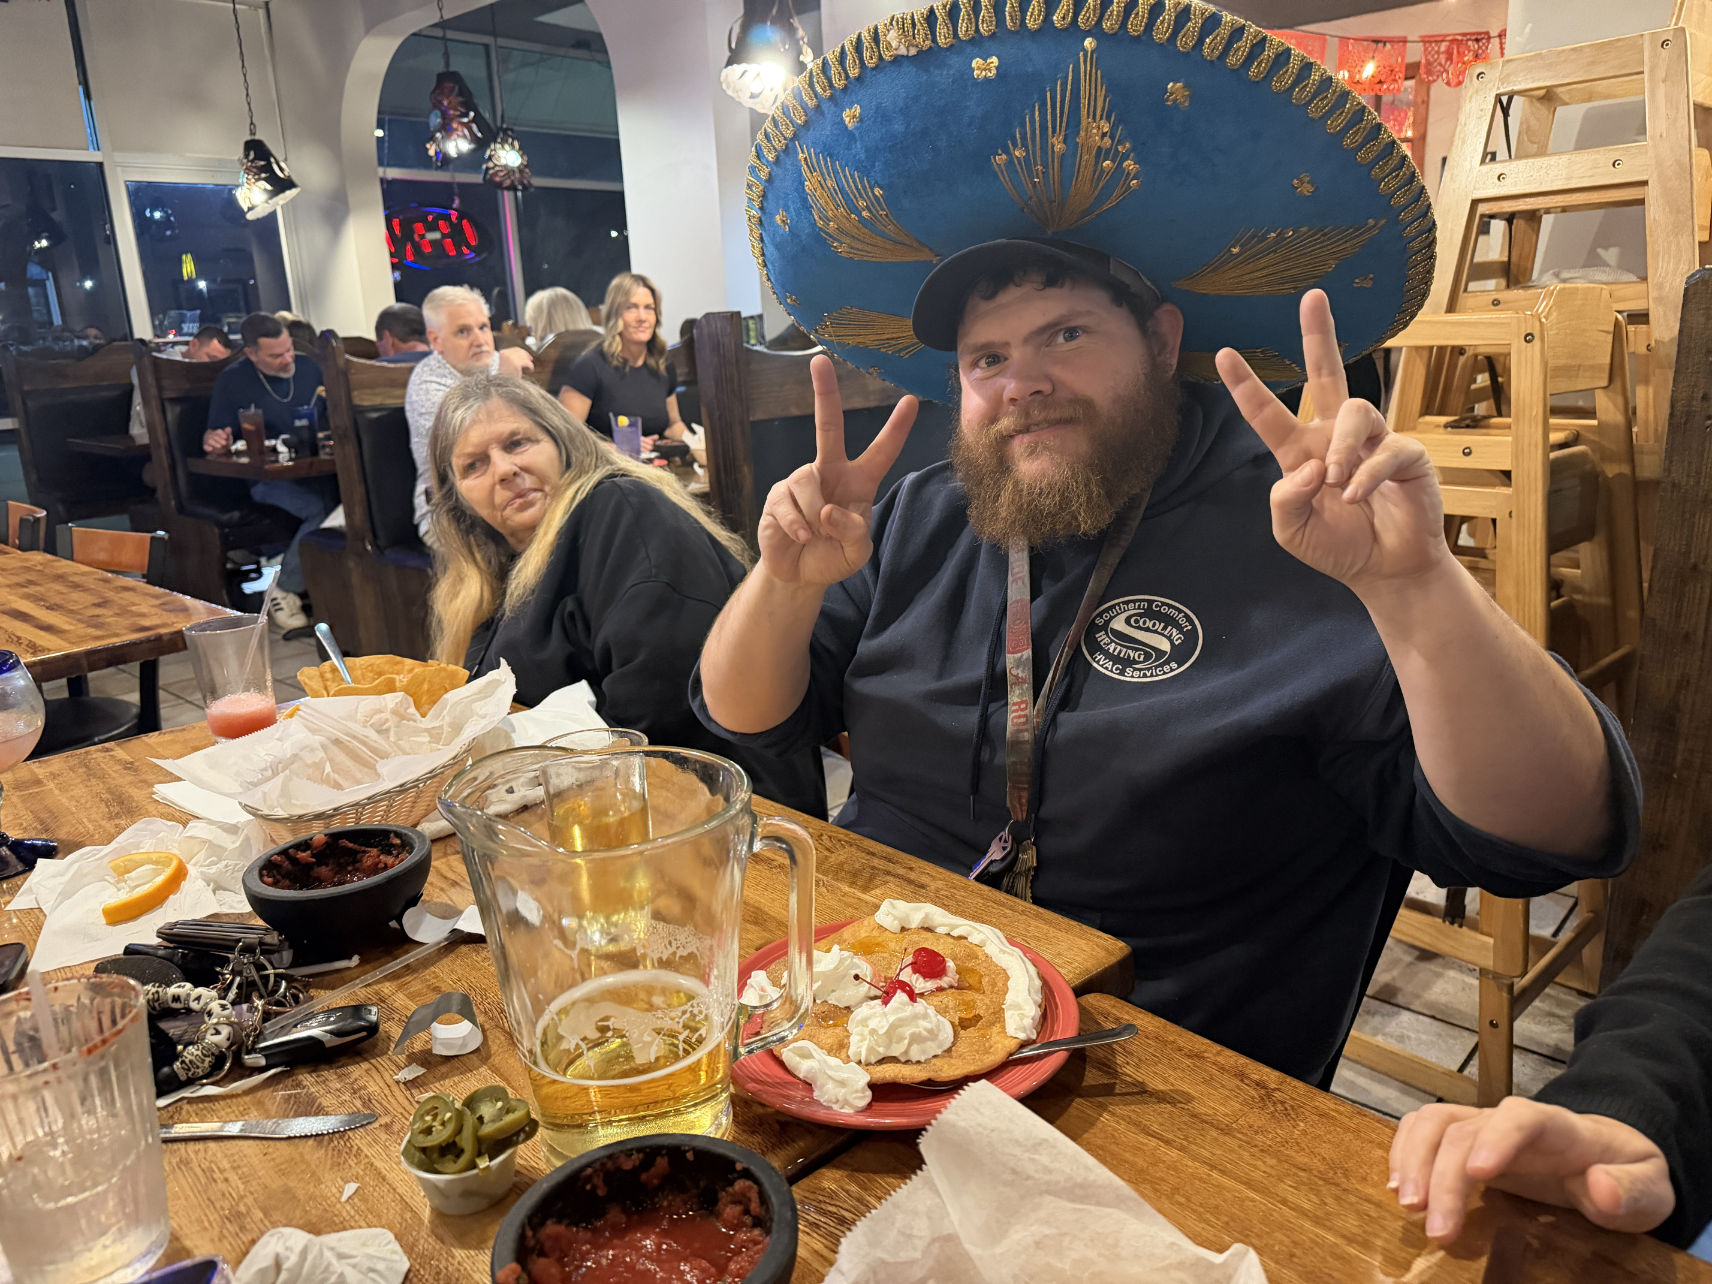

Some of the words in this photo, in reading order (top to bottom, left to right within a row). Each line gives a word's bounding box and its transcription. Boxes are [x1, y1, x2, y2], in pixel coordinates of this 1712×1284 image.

[1094, 601, 1148, 626] Southern
[1152, 601, 1193, 632] Comfort
[1130, 616, 1185, 646] COOLING
[1095, 630, 1145, 662] HEATING
[1092, 651, 1123, 673] HVAC
[1124, 661, 1178, 678] Services
